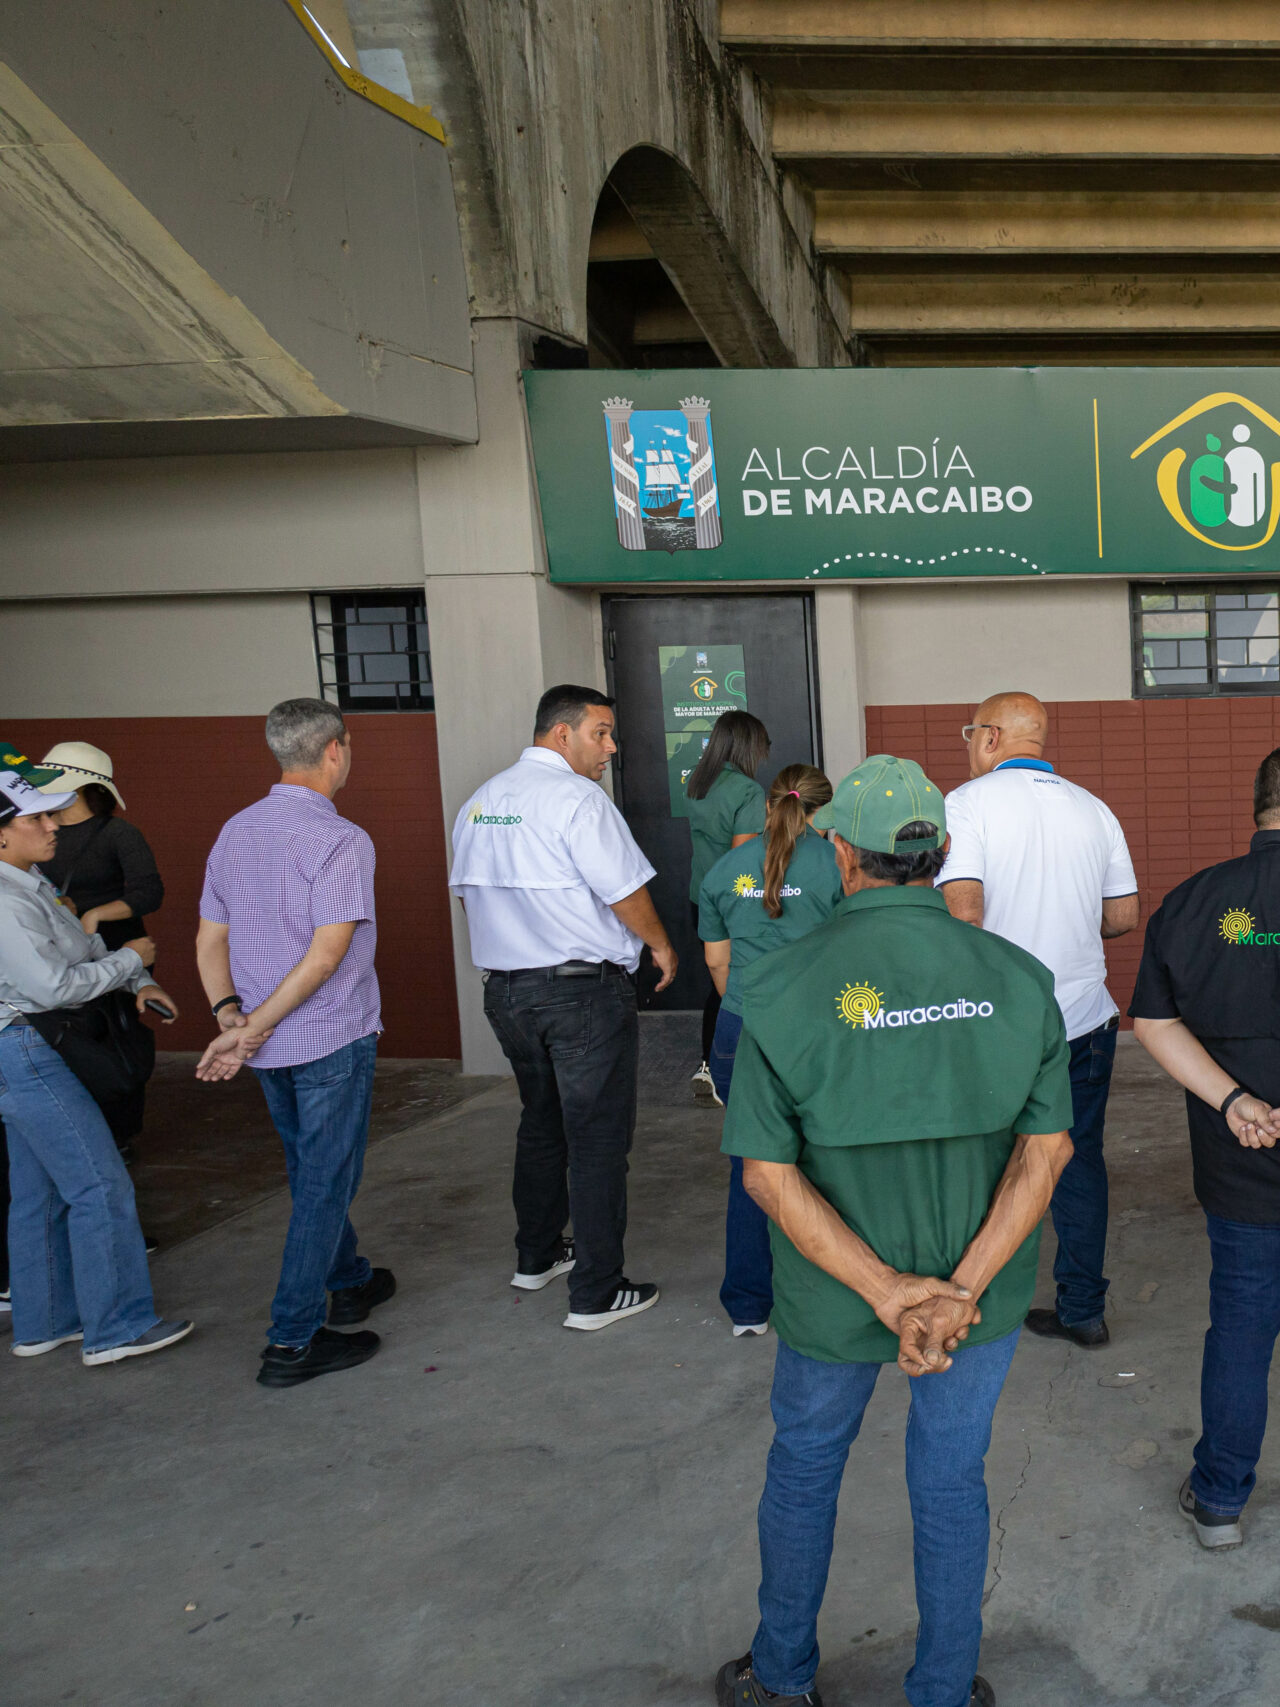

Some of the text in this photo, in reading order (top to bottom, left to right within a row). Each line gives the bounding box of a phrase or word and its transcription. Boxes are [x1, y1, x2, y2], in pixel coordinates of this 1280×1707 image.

[741, 437, 975, 481] ALCALDÍA
[742, 485, 1033, 516] DE MARACAIBO
[743, 884, 802, 898] Maraibo
[864, 998, 994, 1030] Maracaibo
